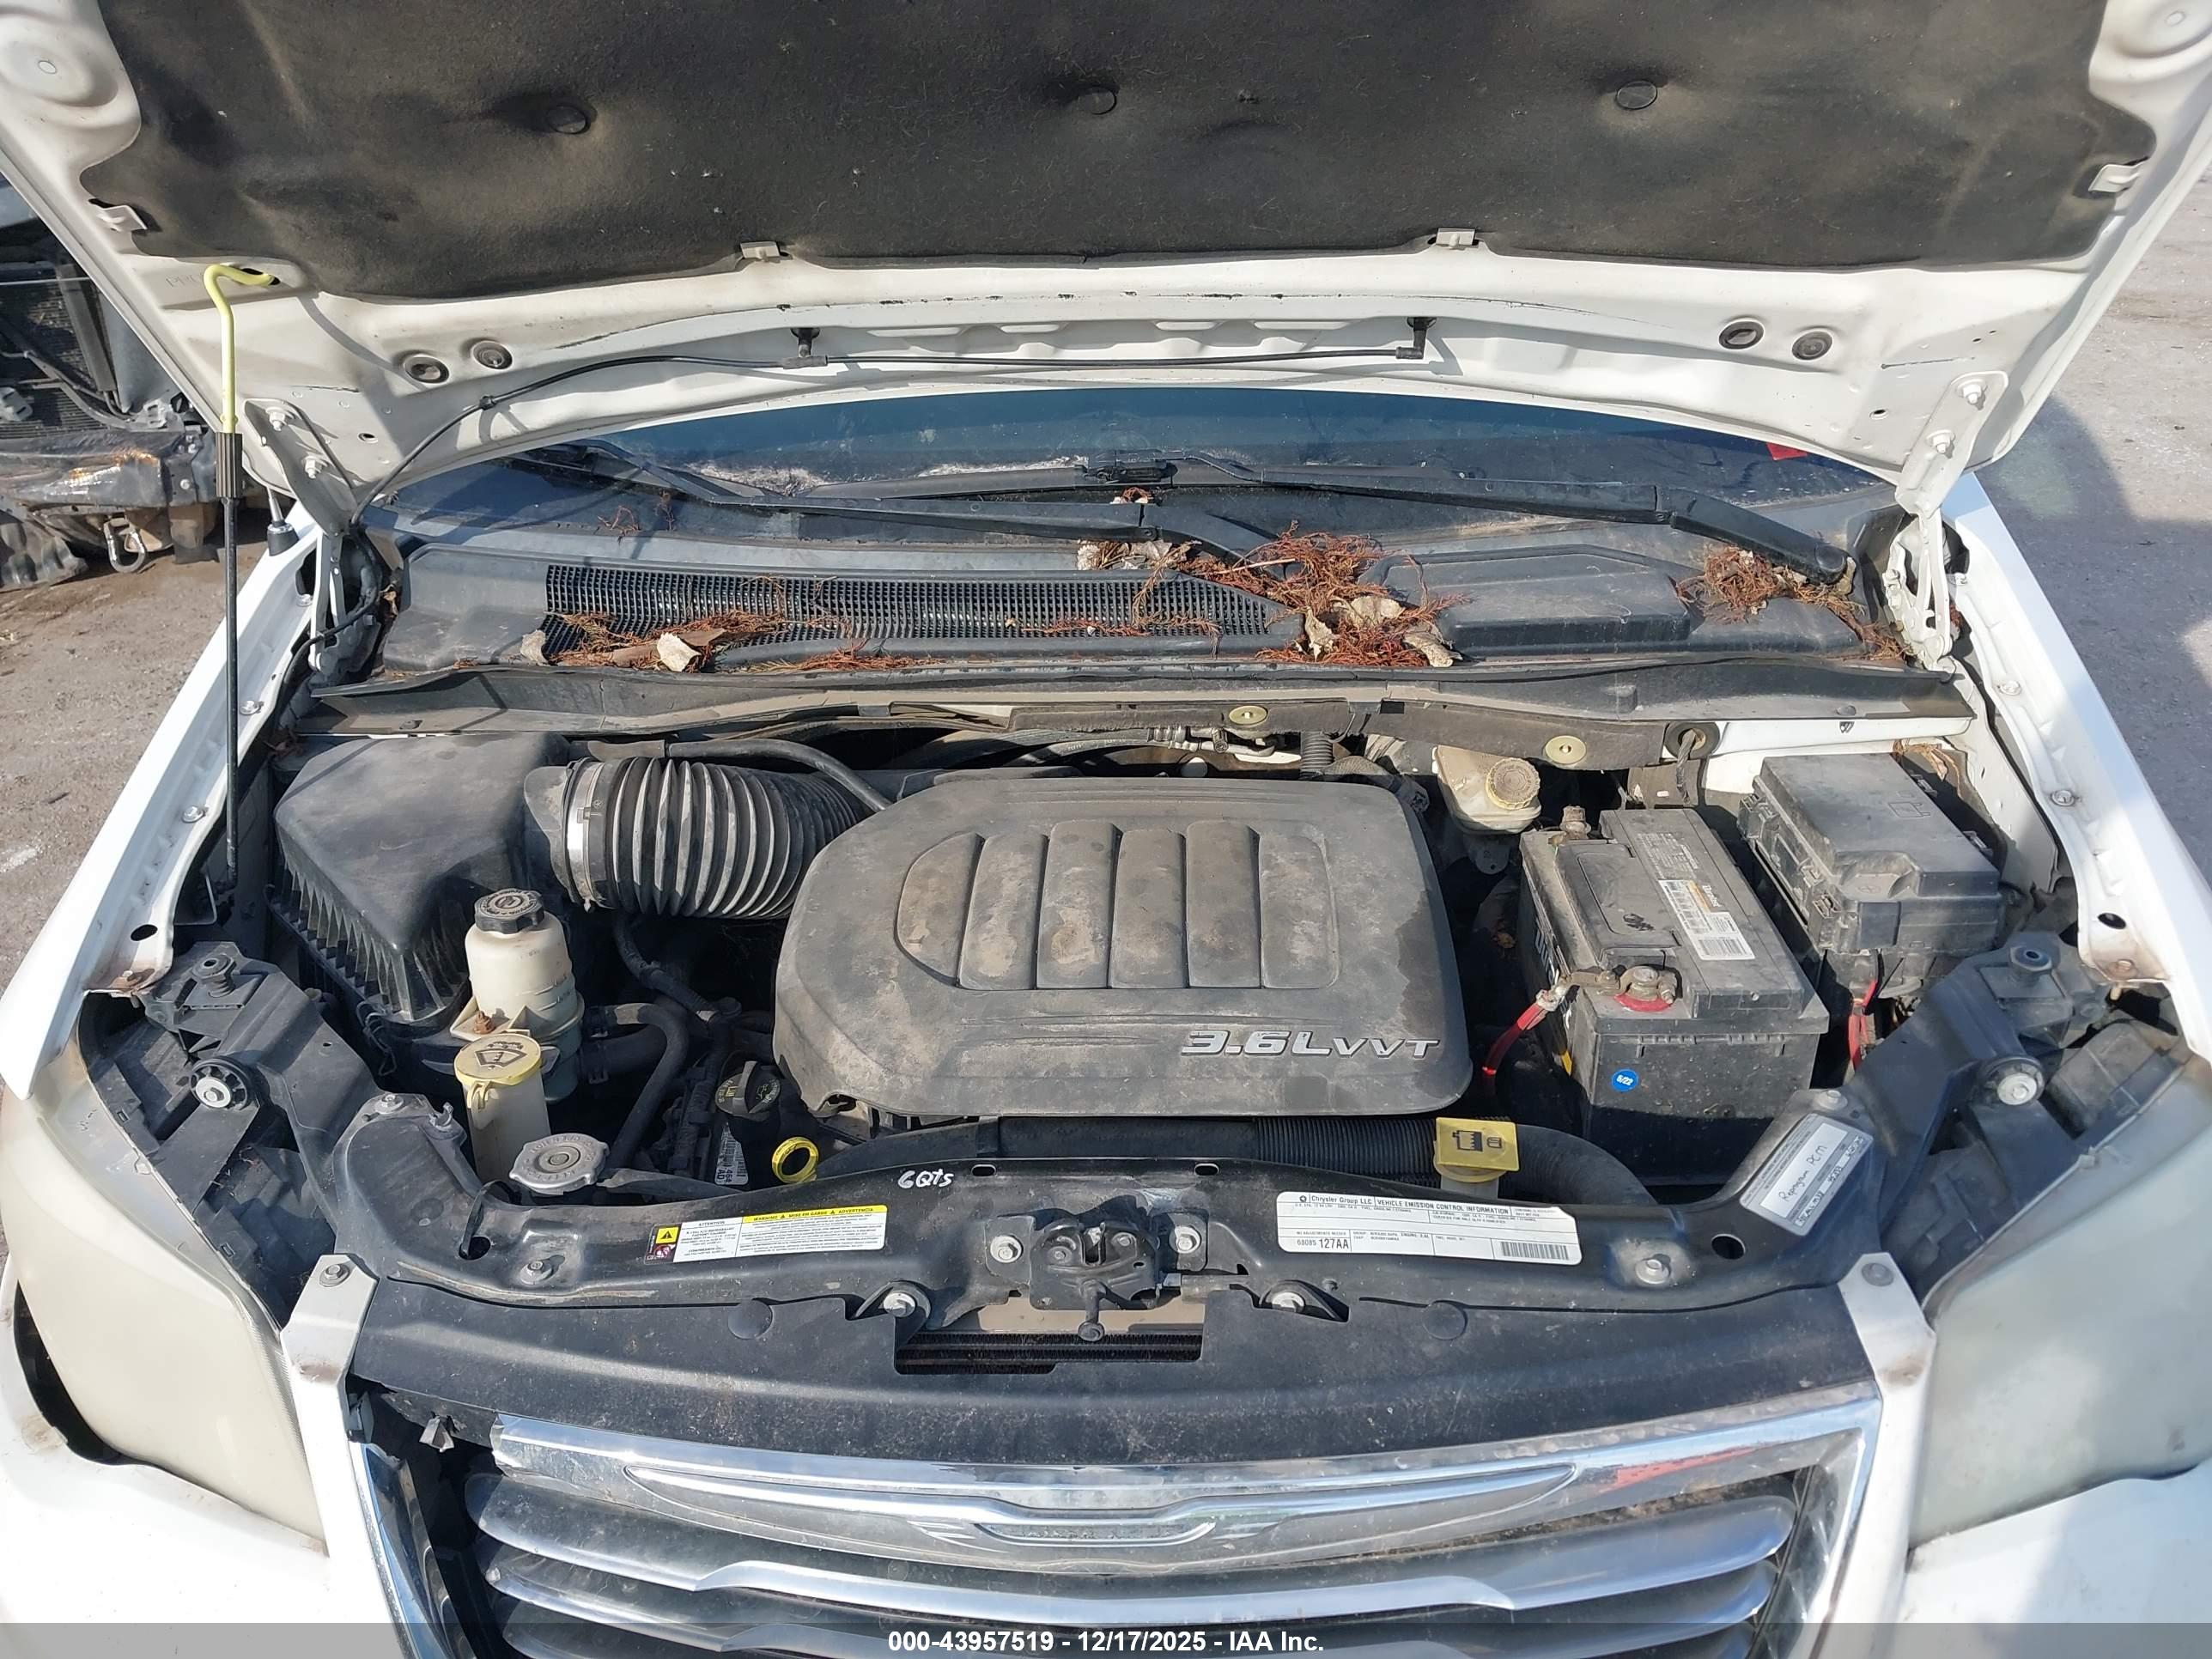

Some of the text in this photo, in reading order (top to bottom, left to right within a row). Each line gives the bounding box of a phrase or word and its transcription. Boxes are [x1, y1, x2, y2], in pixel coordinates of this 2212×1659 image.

[1806, 1145, 1827, 1166] PCM
[1466, 1206, 1509, 1214] INFORMATION
[1319, 1238, 1349, 1249] 127AA
